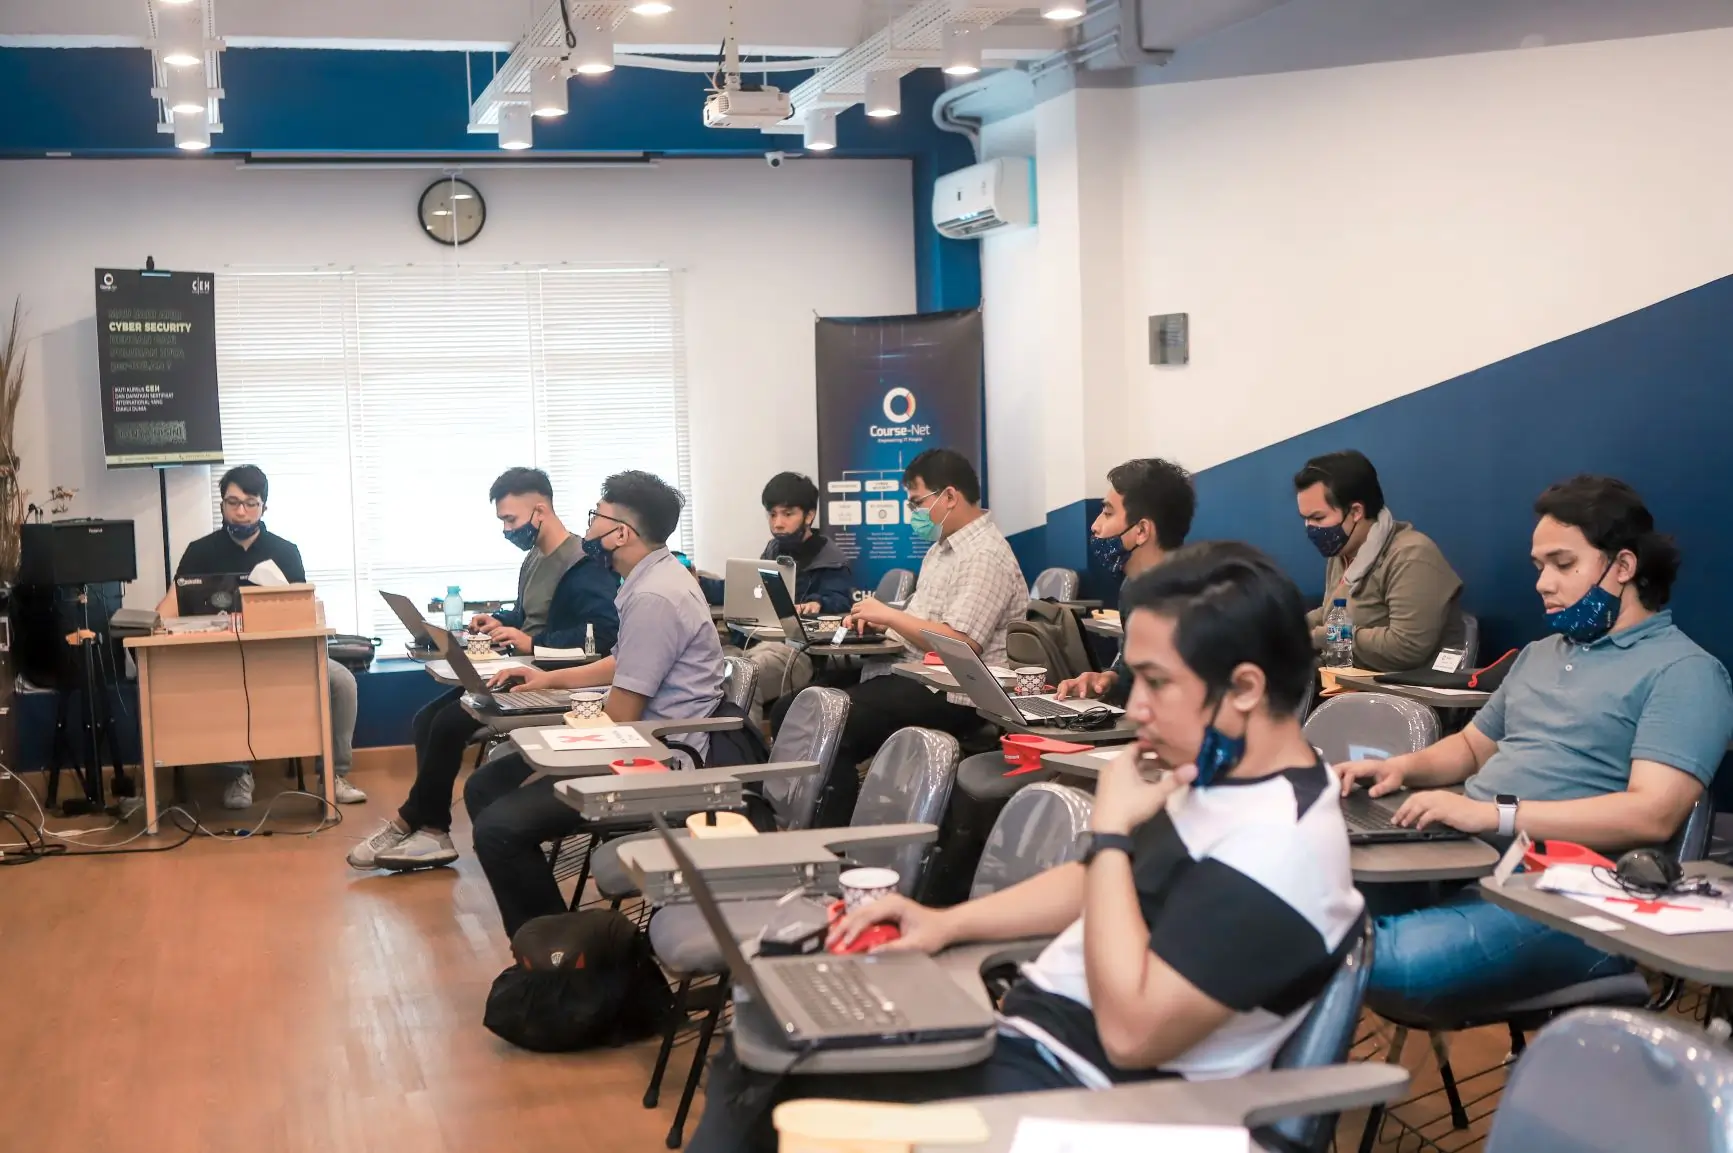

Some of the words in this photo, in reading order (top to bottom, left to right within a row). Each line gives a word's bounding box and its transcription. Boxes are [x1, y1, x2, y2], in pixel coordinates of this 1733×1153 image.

[108, 321, 142, 332] CYBER
[144, 322, 192, 333] SECURITY
[870, 424, 931, 437] Course-Net
